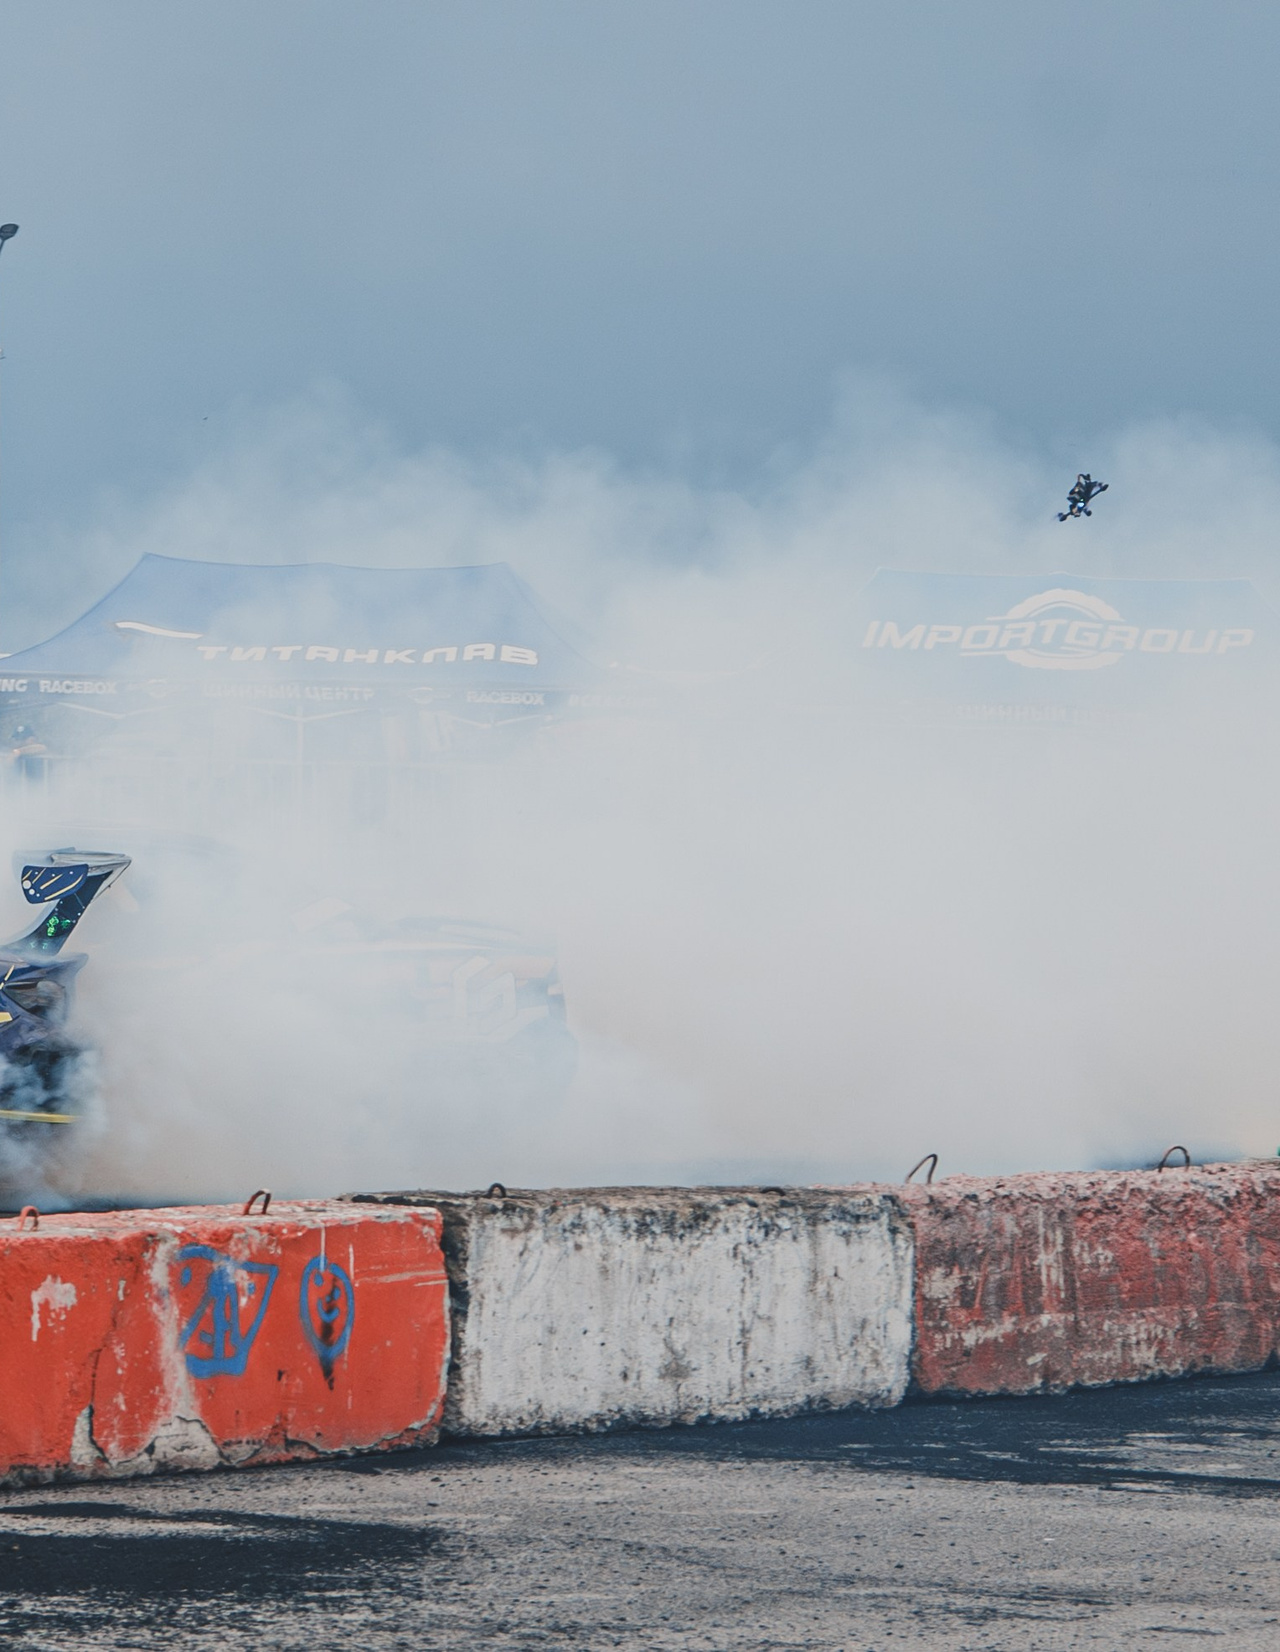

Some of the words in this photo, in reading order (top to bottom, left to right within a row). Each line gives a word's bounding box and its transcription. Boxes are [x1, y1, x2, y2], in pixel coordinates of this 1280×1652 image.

[861, 619, 1254, 654] IMPORTGROUP
[197, 644, 539, 665] ТИТАНКЛАВ
[39, 680, 117, 694] RACEBOX
